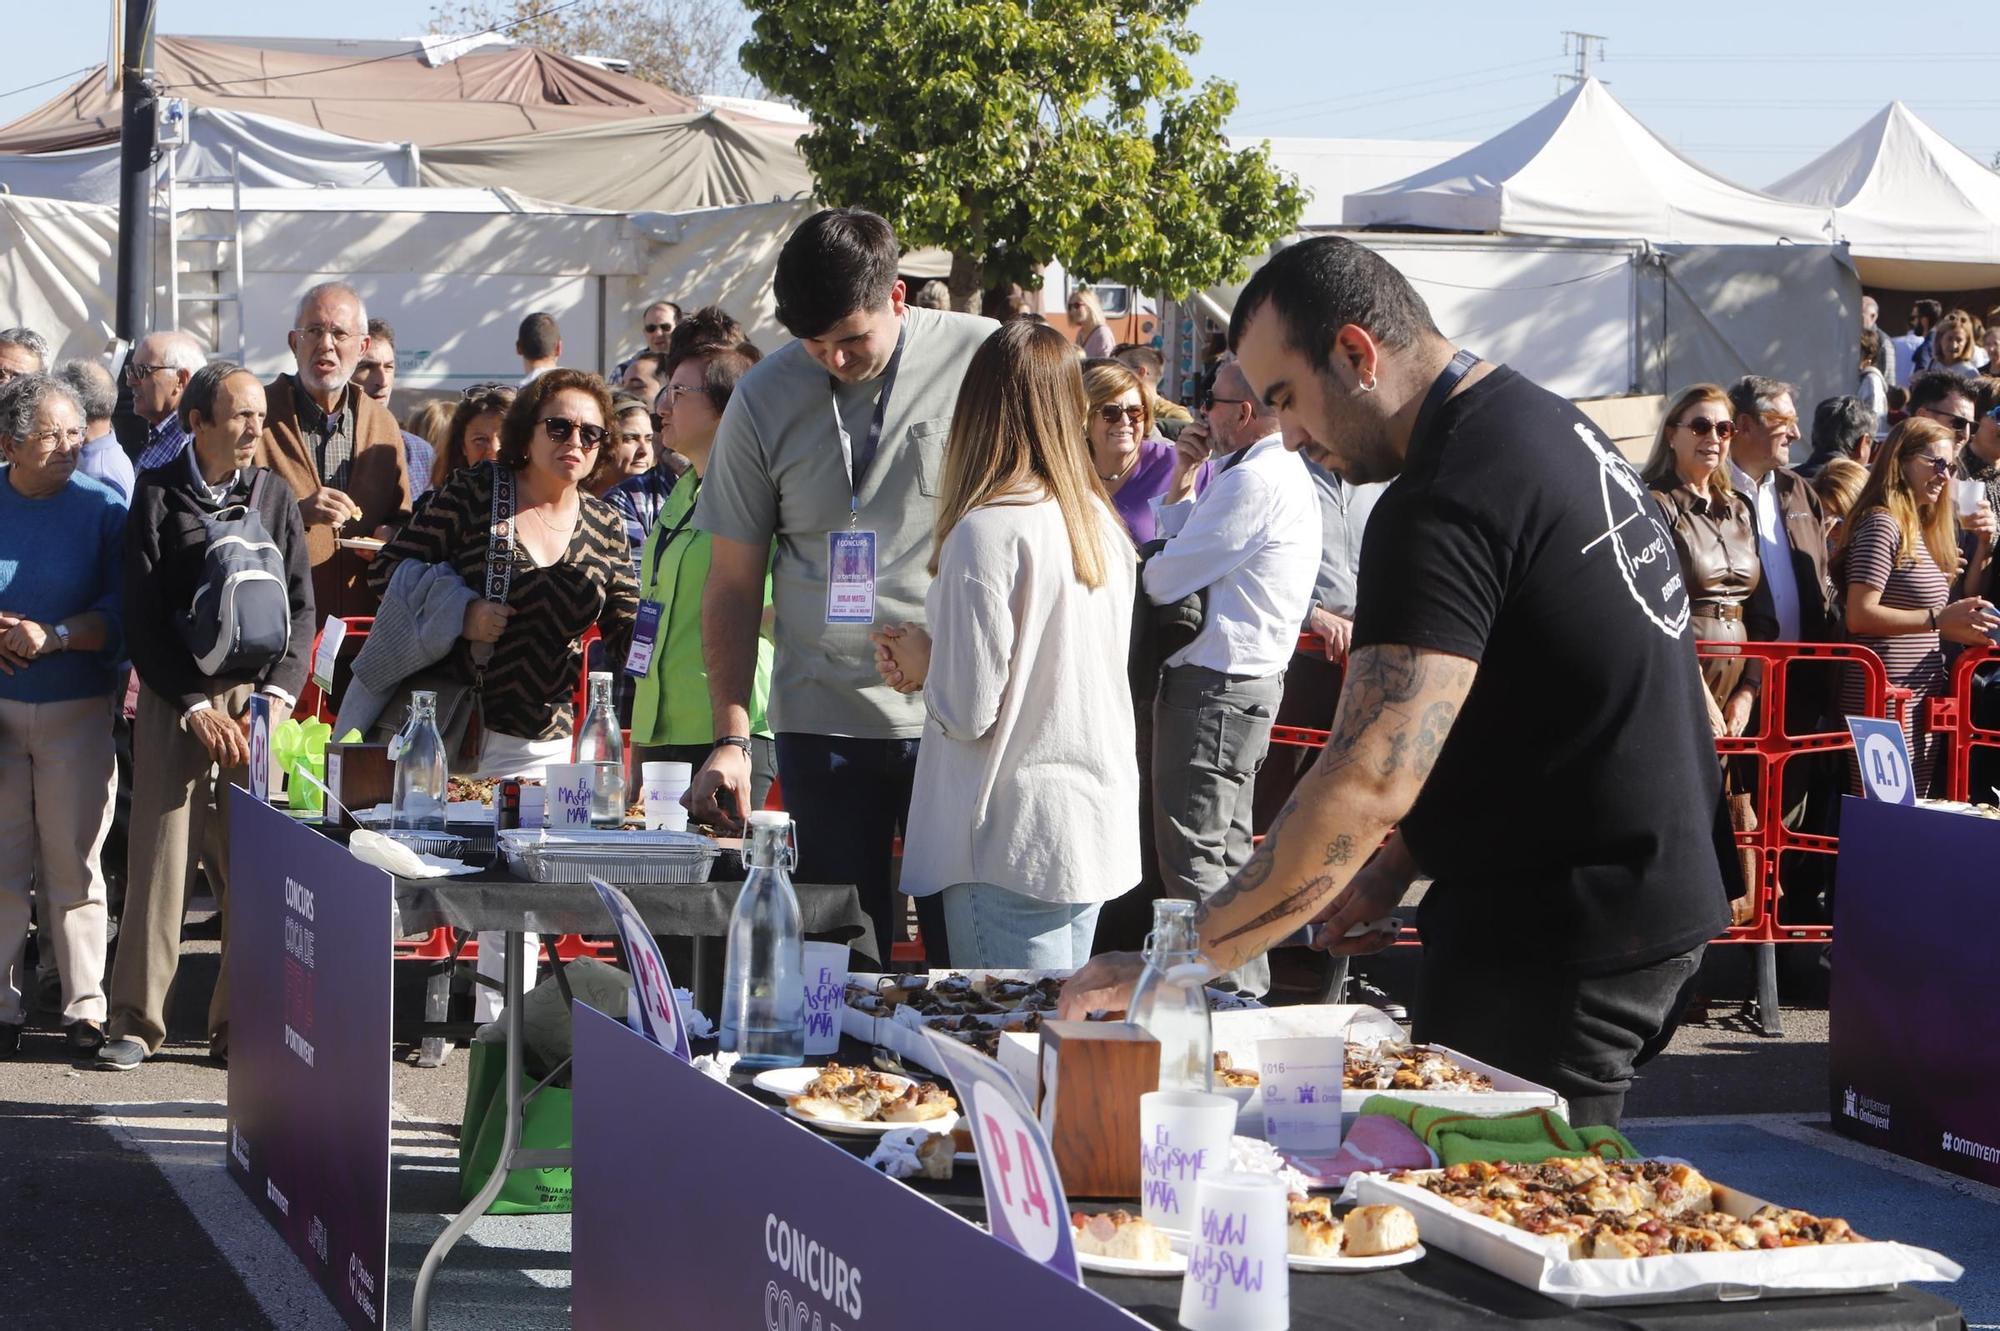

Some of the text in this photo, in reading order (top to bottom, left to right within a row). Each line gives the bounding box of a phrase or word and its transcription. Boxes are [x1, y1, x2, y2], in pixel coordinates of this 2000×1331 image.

[1871, 748, 1900, 787] A.1
[285, 876, 315, 922] CONCURS
[630, 940, 672, 1025] P.3
[1859, 1108, 1890, 1130] Ontinyent
[1860, 1095, 1891, 1116] Ajuntament
[983, 1113, 1051, 1228] P.4
[765, 1213, 862, 1320] CONCURS
